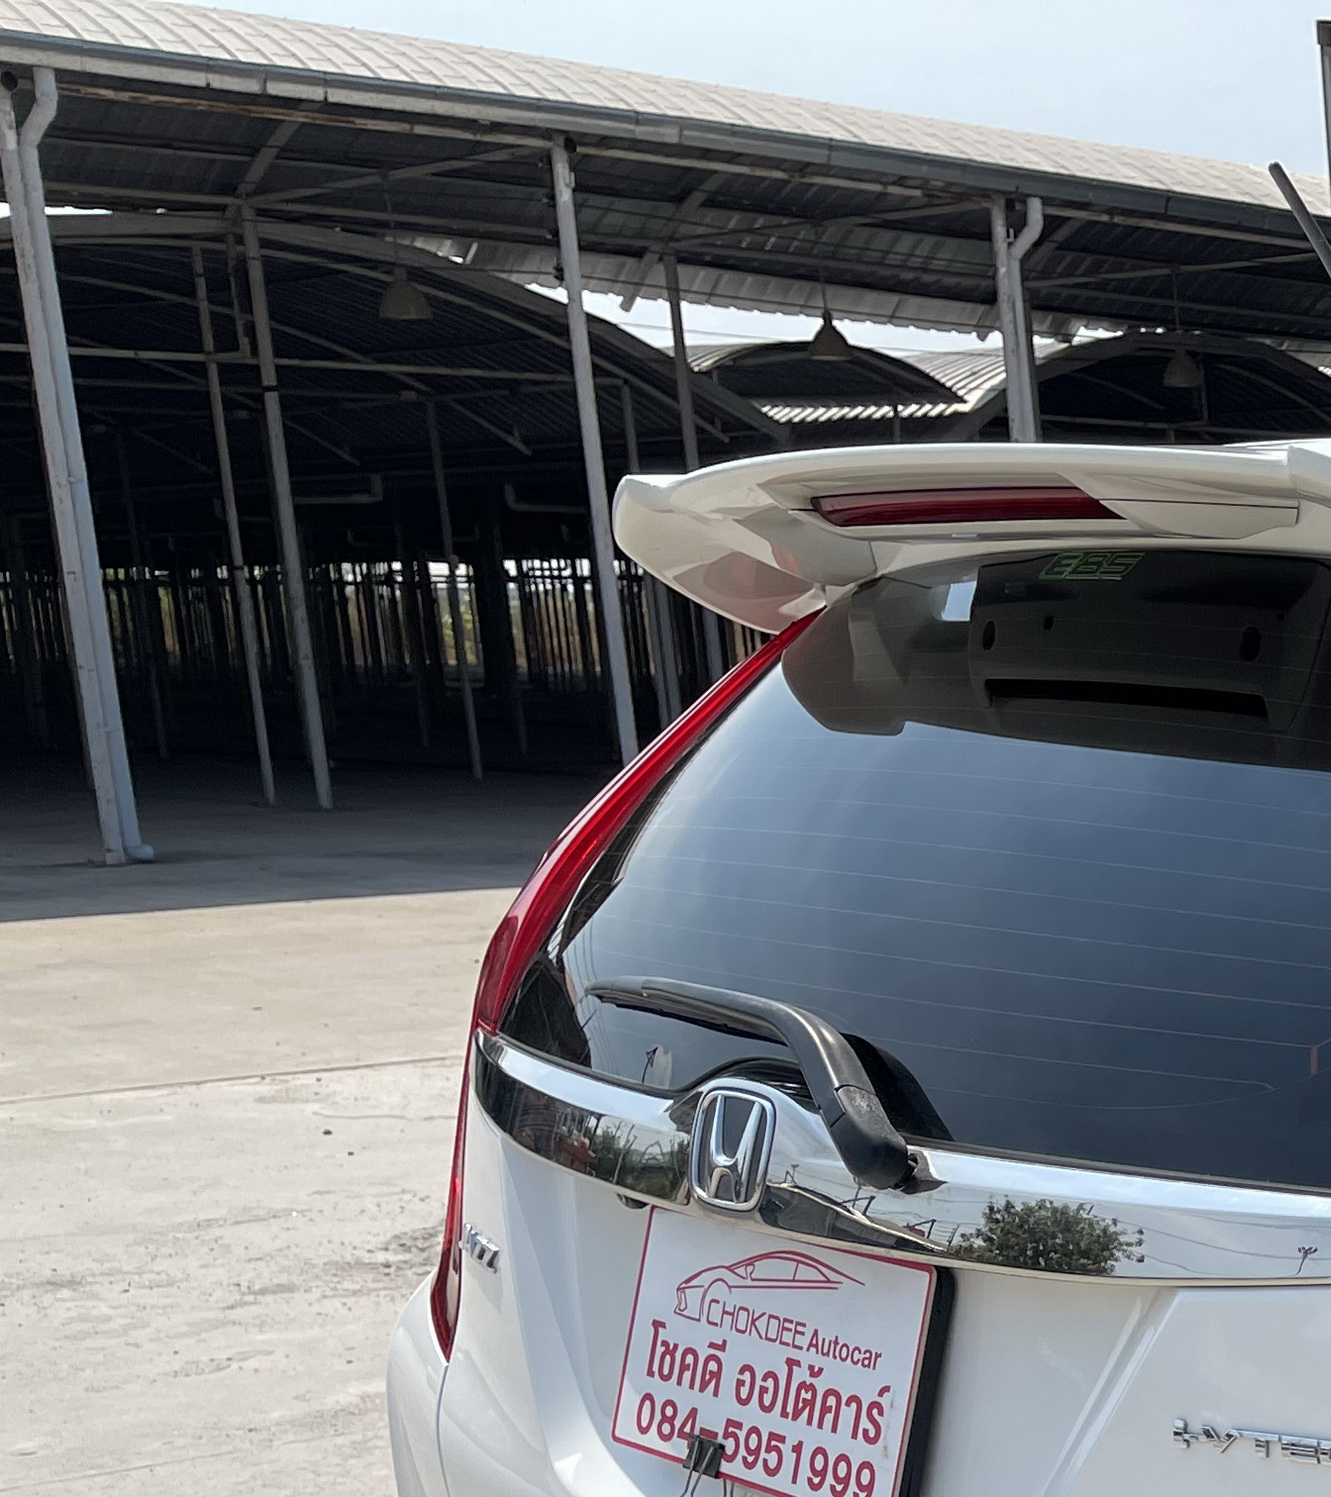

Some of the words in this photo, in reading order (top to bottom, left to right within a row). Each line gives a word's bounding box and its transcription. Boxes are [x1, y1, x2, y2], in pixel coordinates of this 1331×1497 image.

[645, 1318, 729, 1398] โชคดี
[734, 1357, 892, 1446] ออโต้คาร์
[705, 1298, 808, 1352] CHOKDEE
[806, 1328, 883, 1372] Autocar
